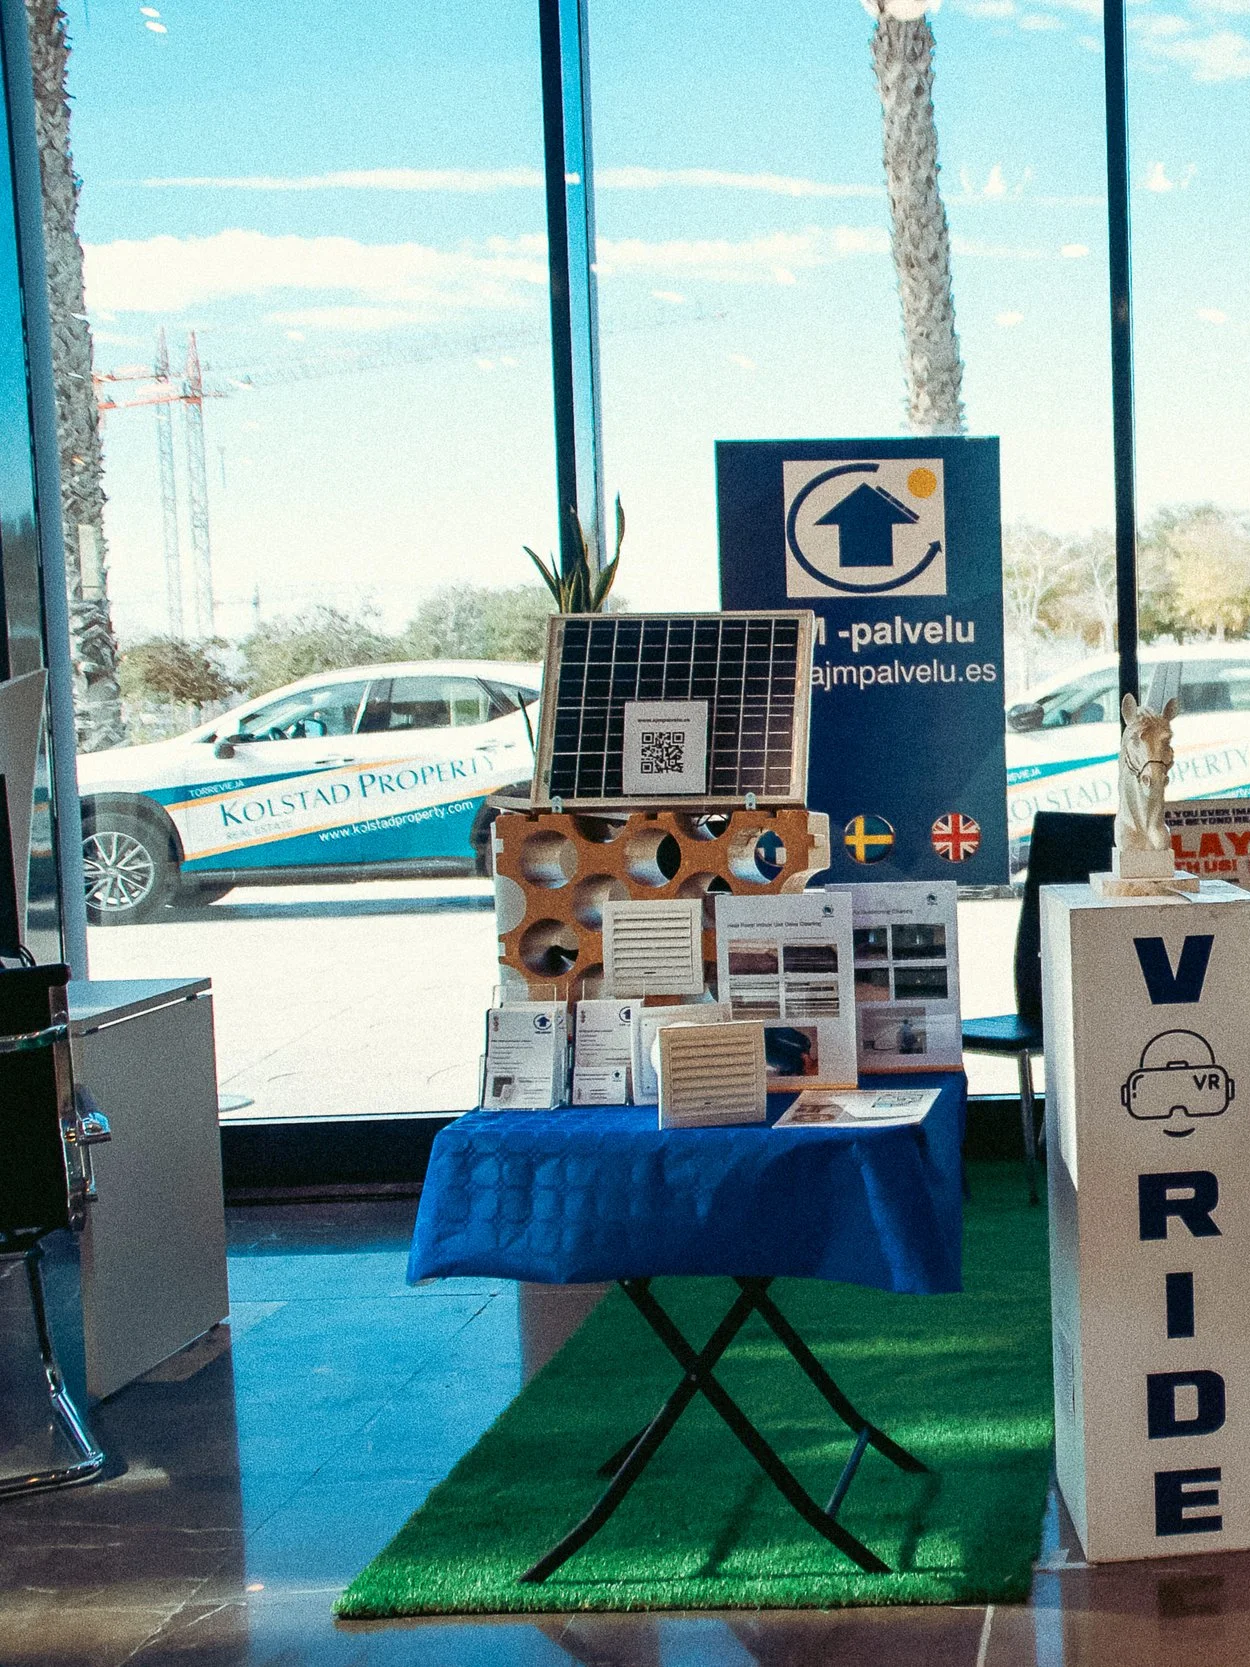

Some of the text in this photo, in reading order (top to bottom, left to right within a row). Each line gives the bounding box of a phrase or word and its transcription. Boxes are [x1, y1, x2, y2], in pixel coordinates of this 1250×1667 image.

[838, 615, 975, 652] -palvelu
[811, 659, 997, 692] ajmpalvelu.es
[189, 780, 245, 798] TORREVIEJA
[219, 755, 494, 827] KOLSTAD PROPERTY
[1009, 780, 1112, 822] OLSTAD
[319, 801, 474, 842] www.kolstadproperty.com
[1174, 809, 1198, 818] YOU
[1185, 816, 1232, 826] BEYOND
[1204, 859, 1237, 873] US!
[1192, 1073, 1220, 1092] VR
